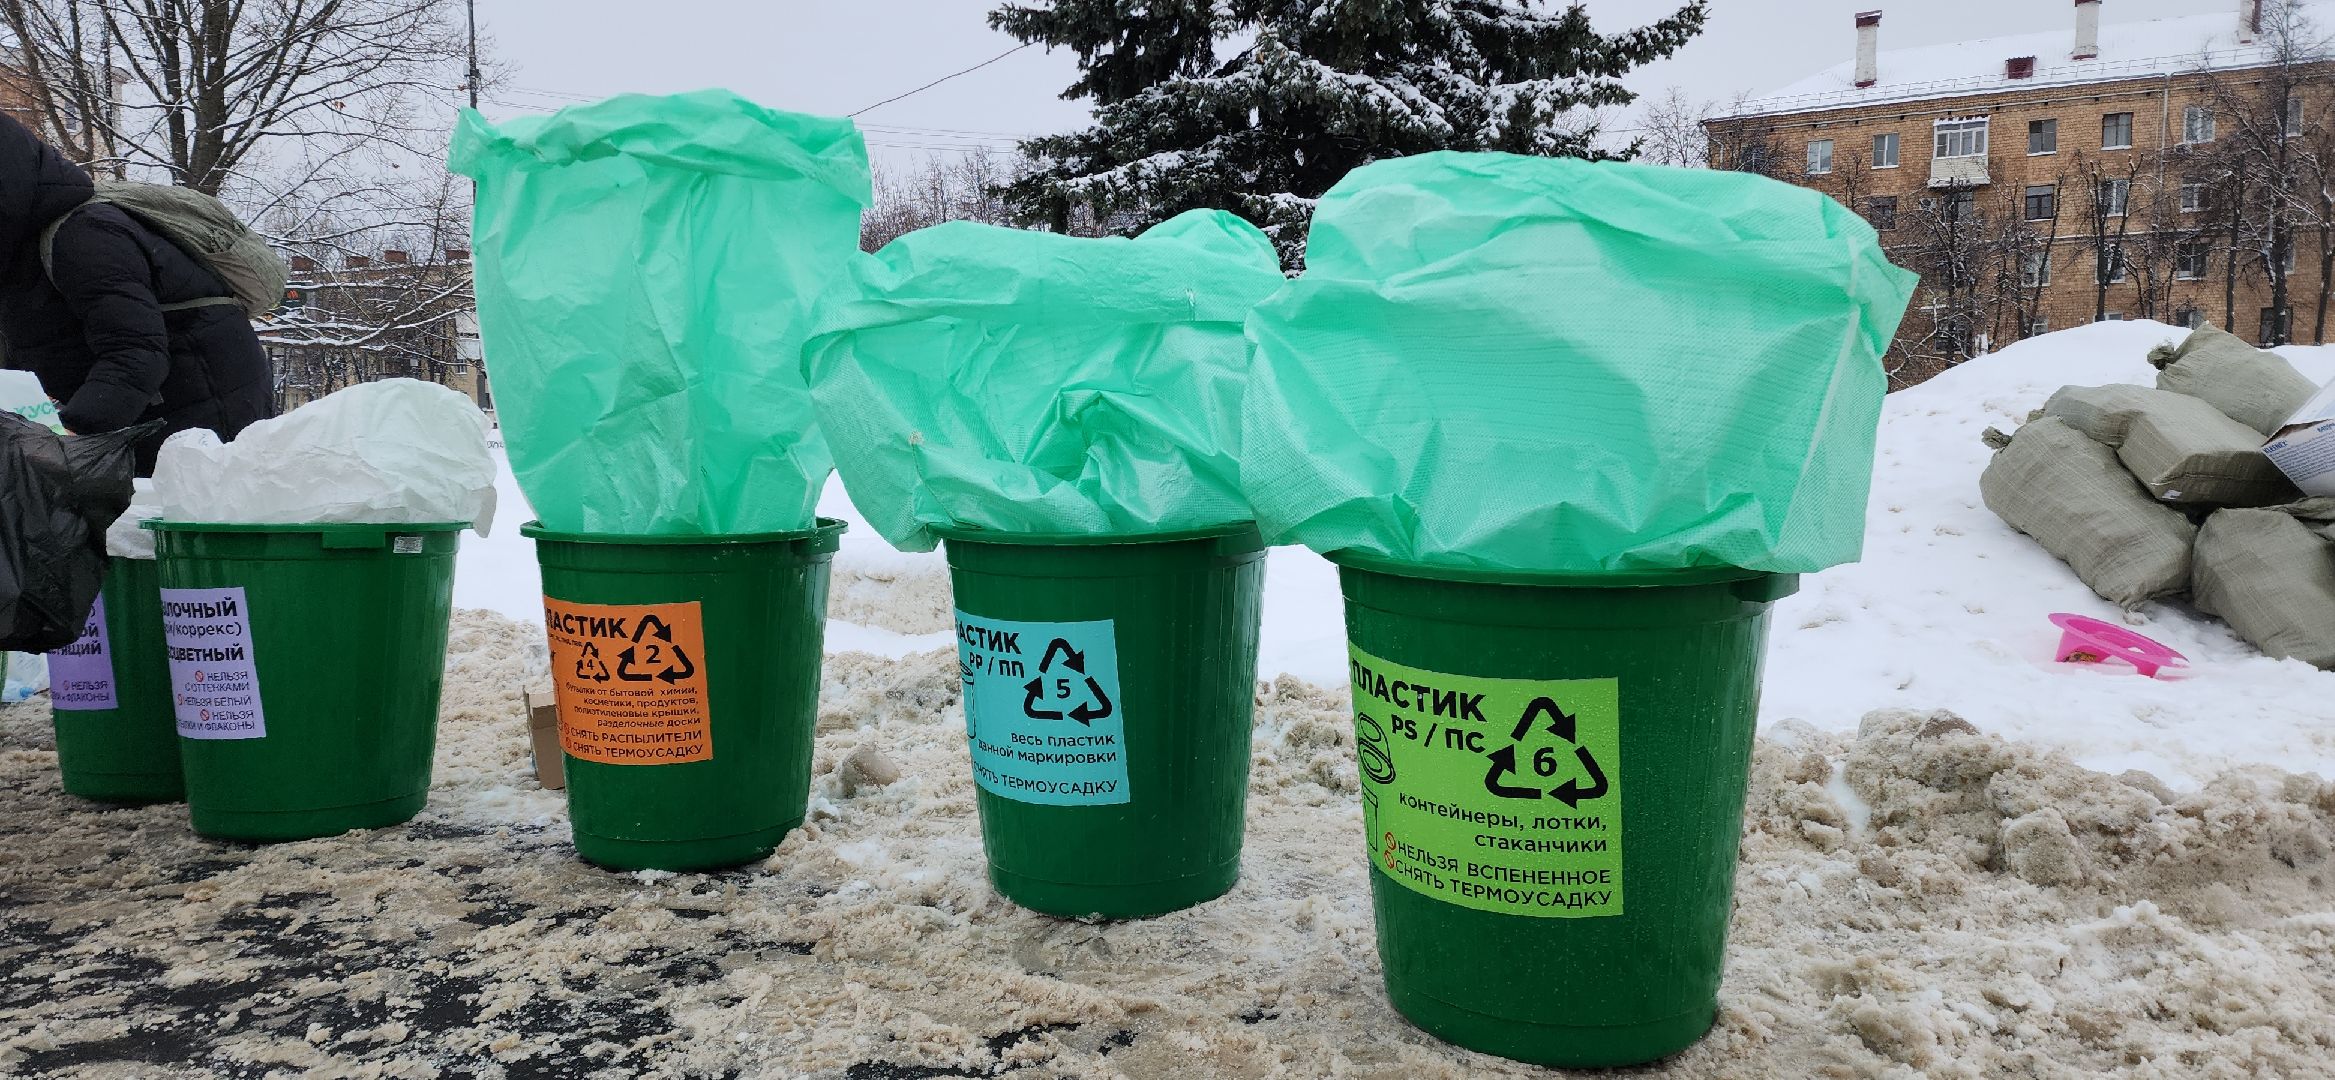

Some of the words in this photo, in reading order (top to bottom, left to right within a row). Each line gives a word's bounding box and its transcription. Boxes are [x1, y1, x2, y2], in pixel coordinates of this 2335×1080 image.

[645, 644, 662, 664] 2
[586, 659, 595, 671] 4
[998, 659, 1025, 678] ПП
[206, 671, 249, 681] НЕЛЬЗЯ
[71, 680, 108, 691] НЕЛЬЗЯ
[597, 688, 607, 697] от
[609, 688, 654, 697] бытовой
[660, 686, 698, 696] химии,
[1056, 678, 1071, 699] 5
[1351, 658, 1488, 723] ПЛАСТИК
[213, 695, 252, 706] БЕЛЫЙ
[583, 697, 635, 709] косметики,
[636, 697, 699, 709] продуктов,
[212, 711, 255, 721] НЕЛЬЗЯ
[574, 706, 649, 718] полиэтиленовые
[204, 720, 255, 731] ФЛАКОНЫ
[597, 719, 665, 728] разделочные
[666, 718, 701, 727] доски
[570, 727, 599, 742] СНЯТЬ
[602, 729, 702, 744] РАСПЫЛИТЕЛИ
[1011, 732, 1043, 747] весь
[1047, 734, 1116, 747] пластик
[1391, 714, 1418, 740] PS
[1445, 728, 1486, 753] ПС
[573, 742, 602, 756] СНЯТЬ
[604, 743, 704, 758] ТЕРМОУСАДКУ
[978, 738, 1014, 759] данной
[1017, 750, 1116, 766] маркировки
[1533, 746, 1557, 777] 6
[974, 761, 999, 784] СНЯТЬ
[1001, 774, 1118, 797] ТЕРМОУСАДКУ
[1399, 792, 1524, 832] контейнеры,
[1532, 816, 1607, 832] лотки,
[1474, 833, 1607, 853] стаканчики
[1398, 840, 1458, 873] НЕЛЬЗЯ
[1467, 862, 1611, 886] ВСПЕНЕННОЕ
[1395, 859, 1445, 890] СНЯТЬ
[1450, 879, 1613, 909] ТЕРМОУСАДКУ
